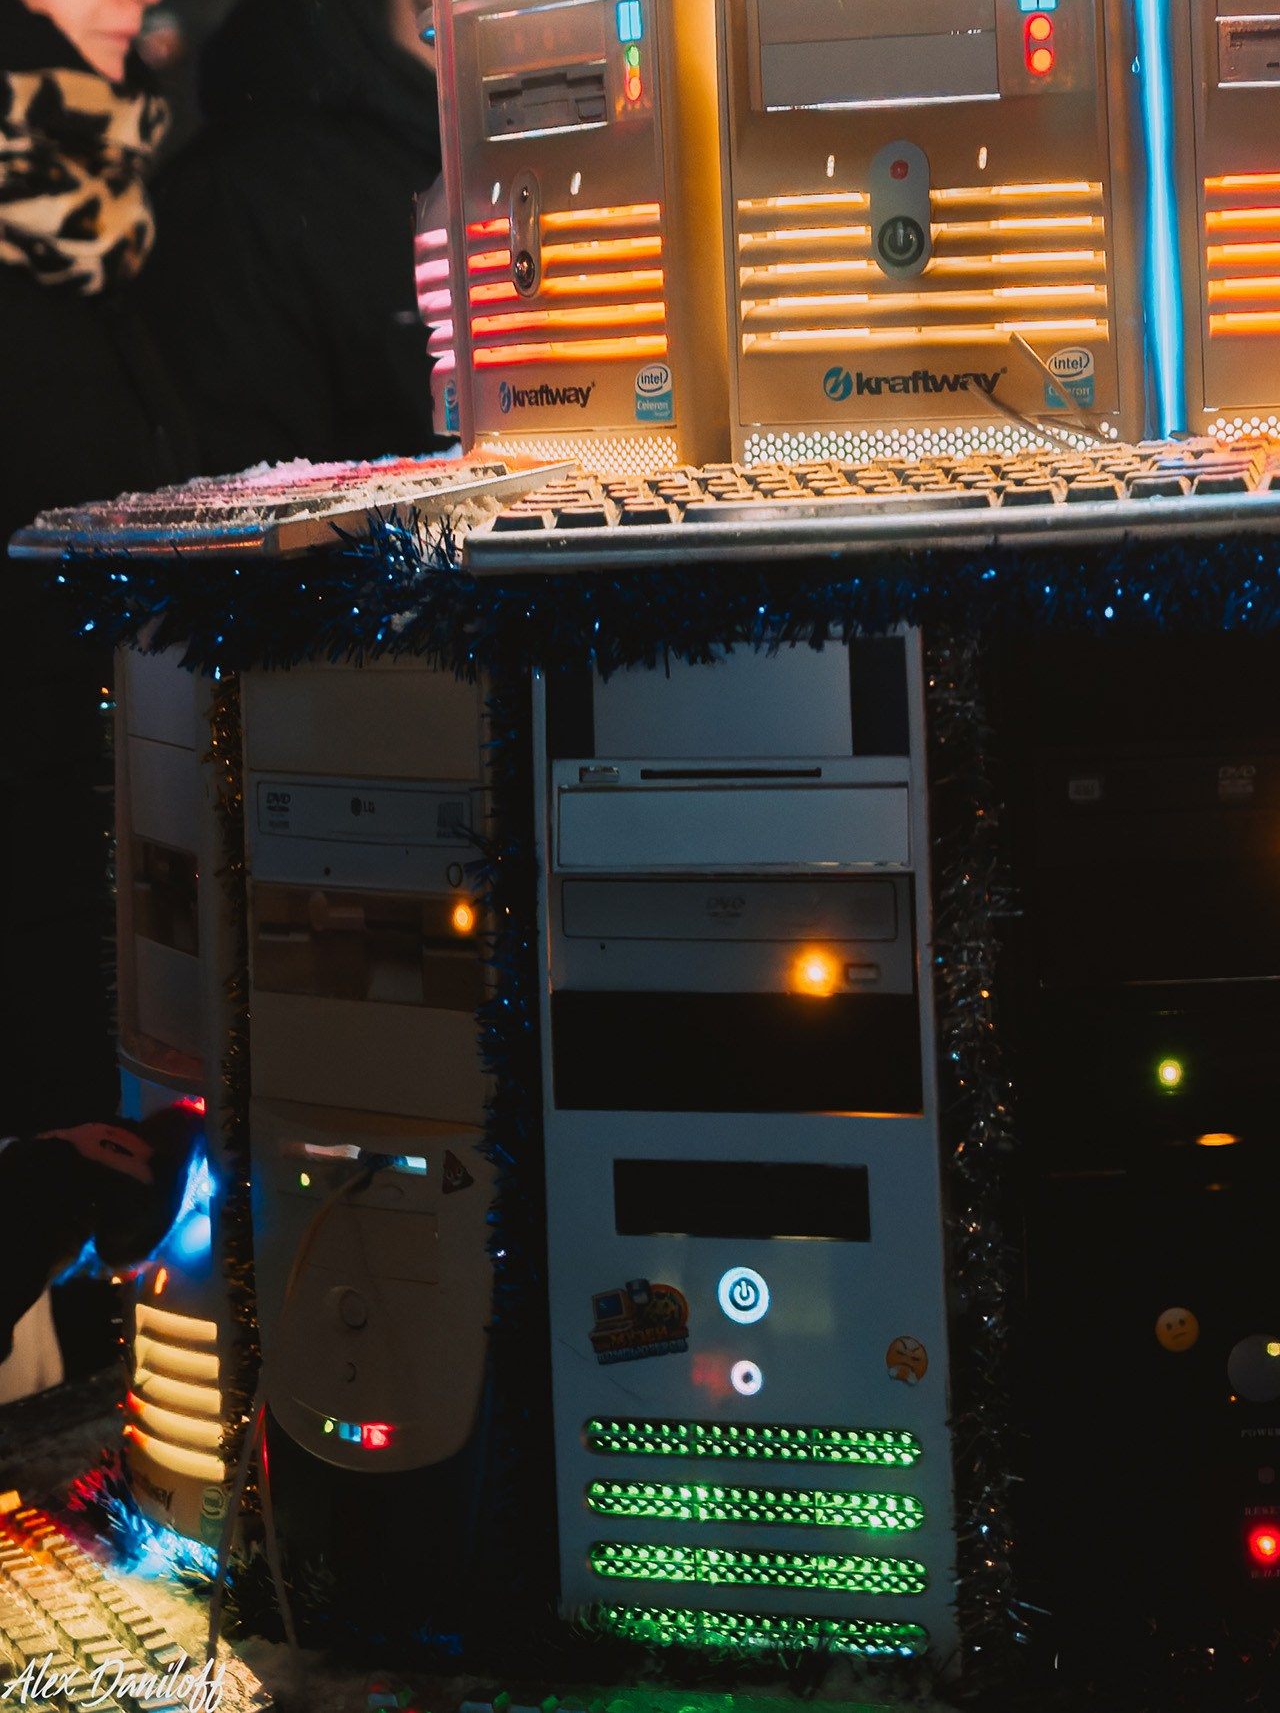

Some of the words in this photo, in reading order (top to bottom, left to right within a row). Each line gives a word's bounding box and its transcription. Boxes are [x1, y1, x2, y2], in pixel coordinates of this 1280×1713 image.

[1054, 356, 1083, 370] intel
[641, 371, 663, 385] intel
[855, 367, 1002, 396] kraftway
[512, 382, 592, 409] kraftway
[1048, 384, 1090, 397] Cron
[637, 399, 669, 411] Celeron
[266, 792, 291, 805] DVD
